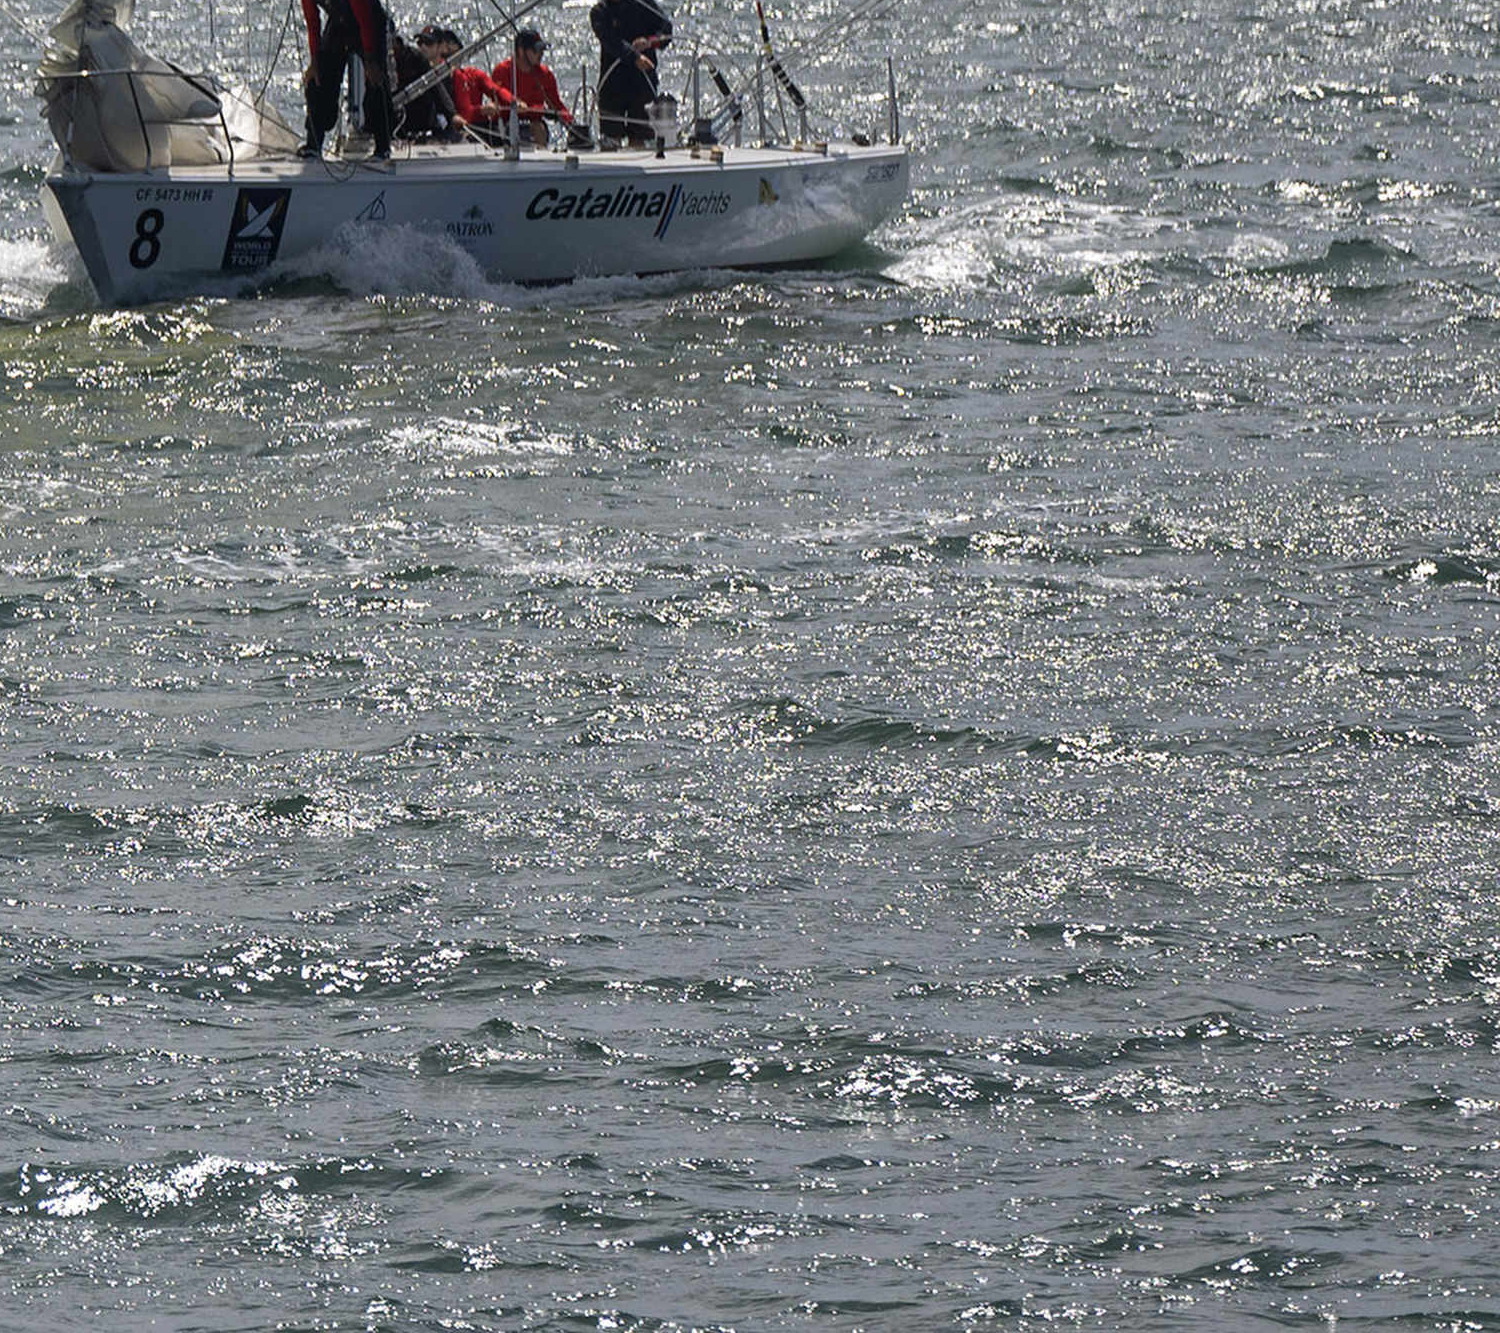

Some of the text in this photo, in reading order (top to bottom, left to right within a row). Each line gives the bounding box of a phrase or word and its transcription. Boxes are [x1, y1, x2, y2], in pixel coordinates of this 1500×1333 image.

[525, 185, 731, 221] Catalina Yachts
[128, 207, 165, 270] 8
